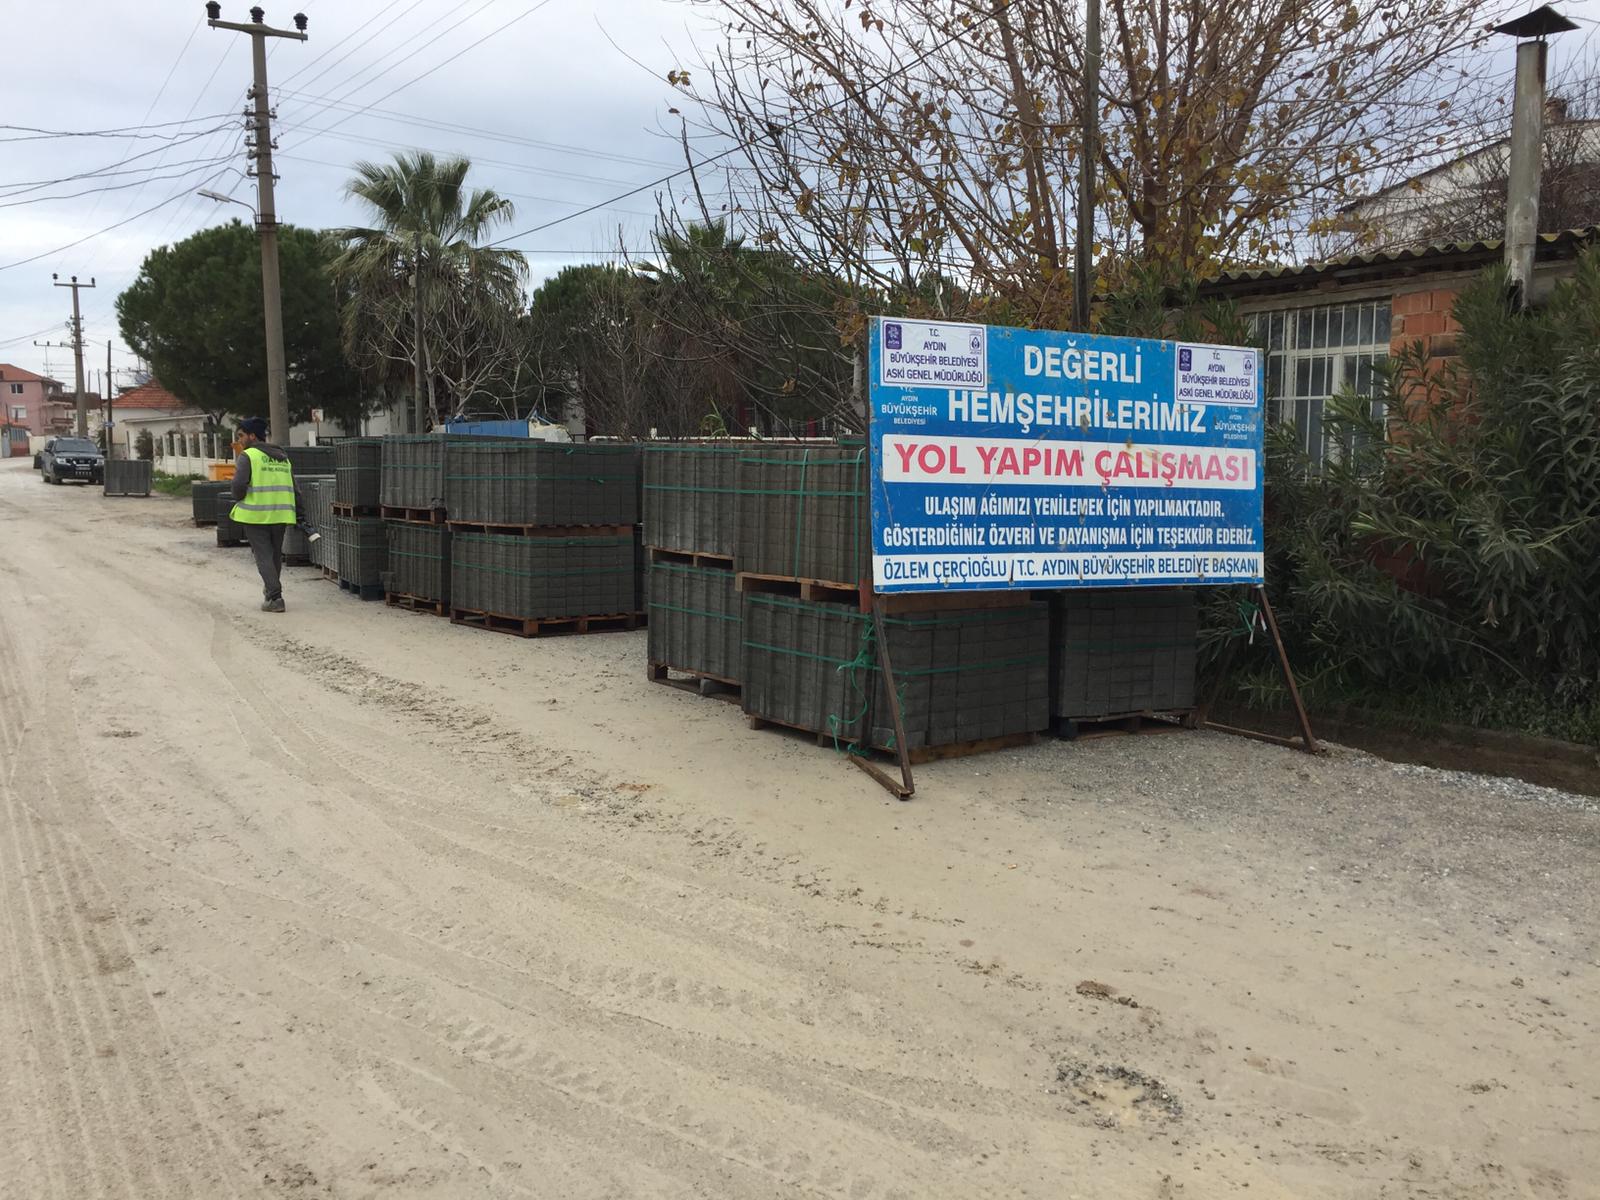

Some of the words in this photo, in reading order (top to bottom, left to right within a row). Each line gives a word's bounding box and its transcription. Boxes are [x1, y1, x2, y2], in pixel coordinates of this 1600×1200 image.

[929, 328, 940, 337] T.C.
[923, 342, 946, 352] AYDIN
[890, 352, 937, 367] BÜYÜKŞEHİR
[938, 356, 978, 368] BELEDİYESİ
[1023, 340, 1142, 384] DEĞERLİ
[886, 368, 904, 378] ASKİ
[906, 370, 932, 380] GENEL
[934, 369, 982, 383] MÜDÜRLÜĞÜ
[1208, 364, 1226, 372] AYDIN
[1182, 374, 1218, 386] BÜYÜKŞEHİR
[1219, 376, 1250, 387] BELEDİYESİ
[1179, 387, 1193, 396] ASKİ
[1194, 389, 1214, 398] GENEL
[1215, 389, 1254, 400] MÜDÜRLÜĞÜ
[881, 402, 938, 417] BÜYÜKŞEHİR
[948, 388, 1206, 434] HEMŞEHRİLERİMİZ
[894, 444, 966, 475] YOL
[976, 446, 1083, 477] YAPIM
[1094, 450, 1248, 487] ÇALIŞMASI
[924, 496, 976, 520] ULAŞIM
[980, 492, 1030, 516] AĞIMIZI
[1034, 494, 1104, 516] YENİLEMEK
[1107, 494, 1130, 520] İÇİN
[1134, 498, 1225, 518] YAPILMAKTADIR.
[883, 523, 986, 547] GÖSTERDİĞİNİZ
[989, 523, 1035, 546] ÖZVERİ
[1038, 527, 1054, 546] VE
[1059, 526, 1128, 549] DAYANIŞMA
[1130, 524, 1154, 549] İÇİN
[1157, 524, 1213, 548] TEŞEKKÜR
[1216, 524, 1256, 545] EDERİZ.
[884, 558, 929, 580] ÖZLEM
[932, 556, 1006, 583] ÇERÇİOĞLU
[1017, 559, 1038, 576] T.C.
[1042, 558, 1079, 576] AYDIN
[1082, 555, 1155, 579] BÜYÜKŞEHİR
[1158, 554, 1209, 574] BELEDİYE
[1212, 558, 1258, 577] BAŞKANI
